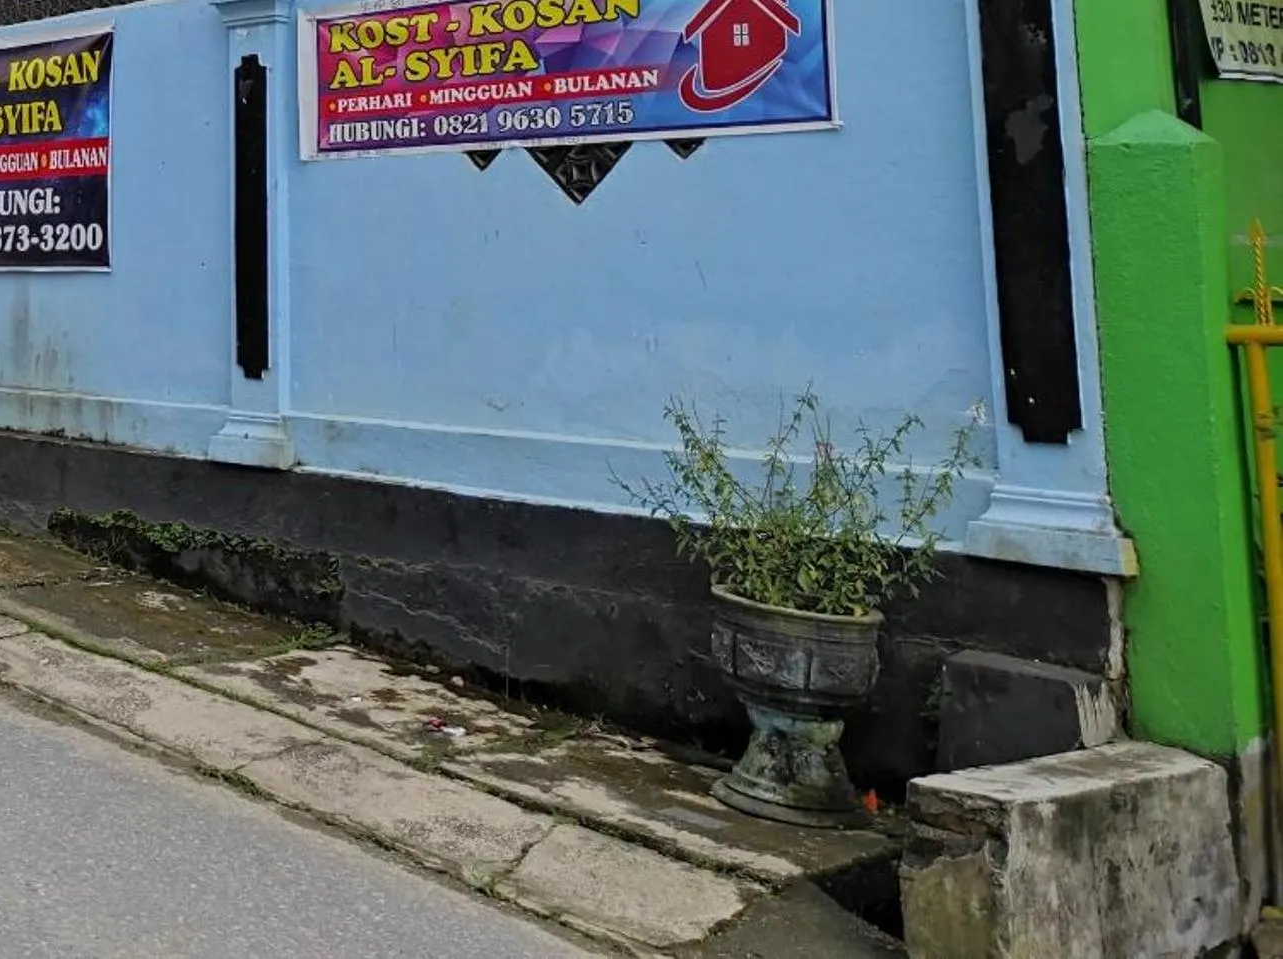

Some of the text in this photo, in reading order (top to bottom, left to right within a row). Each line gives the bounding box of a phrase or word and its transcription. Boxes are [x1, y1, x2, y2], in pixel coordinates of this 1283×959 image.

[328, 12, 439, 54] KOST
[8, 50, 102, 93] KOSAN
[336, 69, 660, 113] PERHARI MINGGUAN BULANAN
[328, 101, 635, 145] HUBUNGI: 0821 9630 5715
[49, 146, 109, 170] BULANAN
